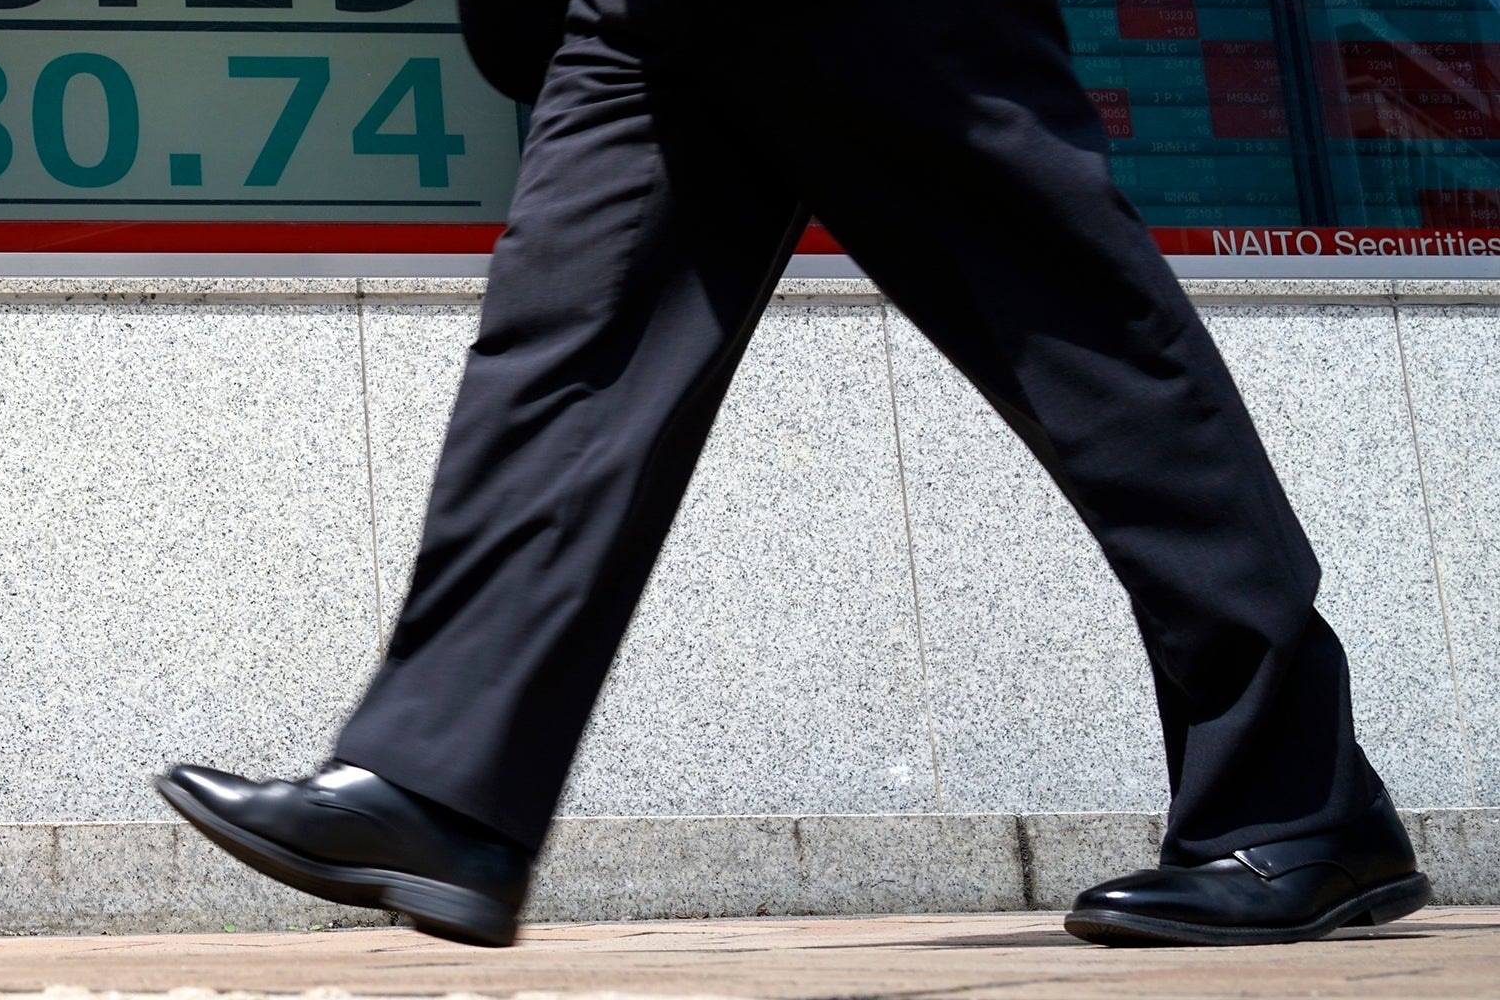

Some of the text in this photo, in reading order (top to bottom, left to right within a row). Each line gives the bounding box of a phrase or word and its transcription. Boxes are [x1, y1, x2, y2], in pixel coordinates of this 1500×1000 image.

[1158, 11, 1194, 20] 1323.0
[1167, 27, 1195, 36] +12.0
[1341, 44, 1372, 55] イオン
[1366, 60, 1393, 70] 3294
[1377, 77, 1396, 86] +20
[1452, 78, 1475, 87] +9.5
[1154, 93, 1185, 103] JPX
[1226, 93, 1269, 103] MS&AD
[1100, 108, 1128, 118] 3052
[1454, 111, 1481, 120] 5216
[1107, 125, 1129, 135] 10.0
[1458, 127, 1484, 136] +133
[1471, 210, 1497, 219] 4895
[1212, 230, 1500, 257] NAITO Securities
